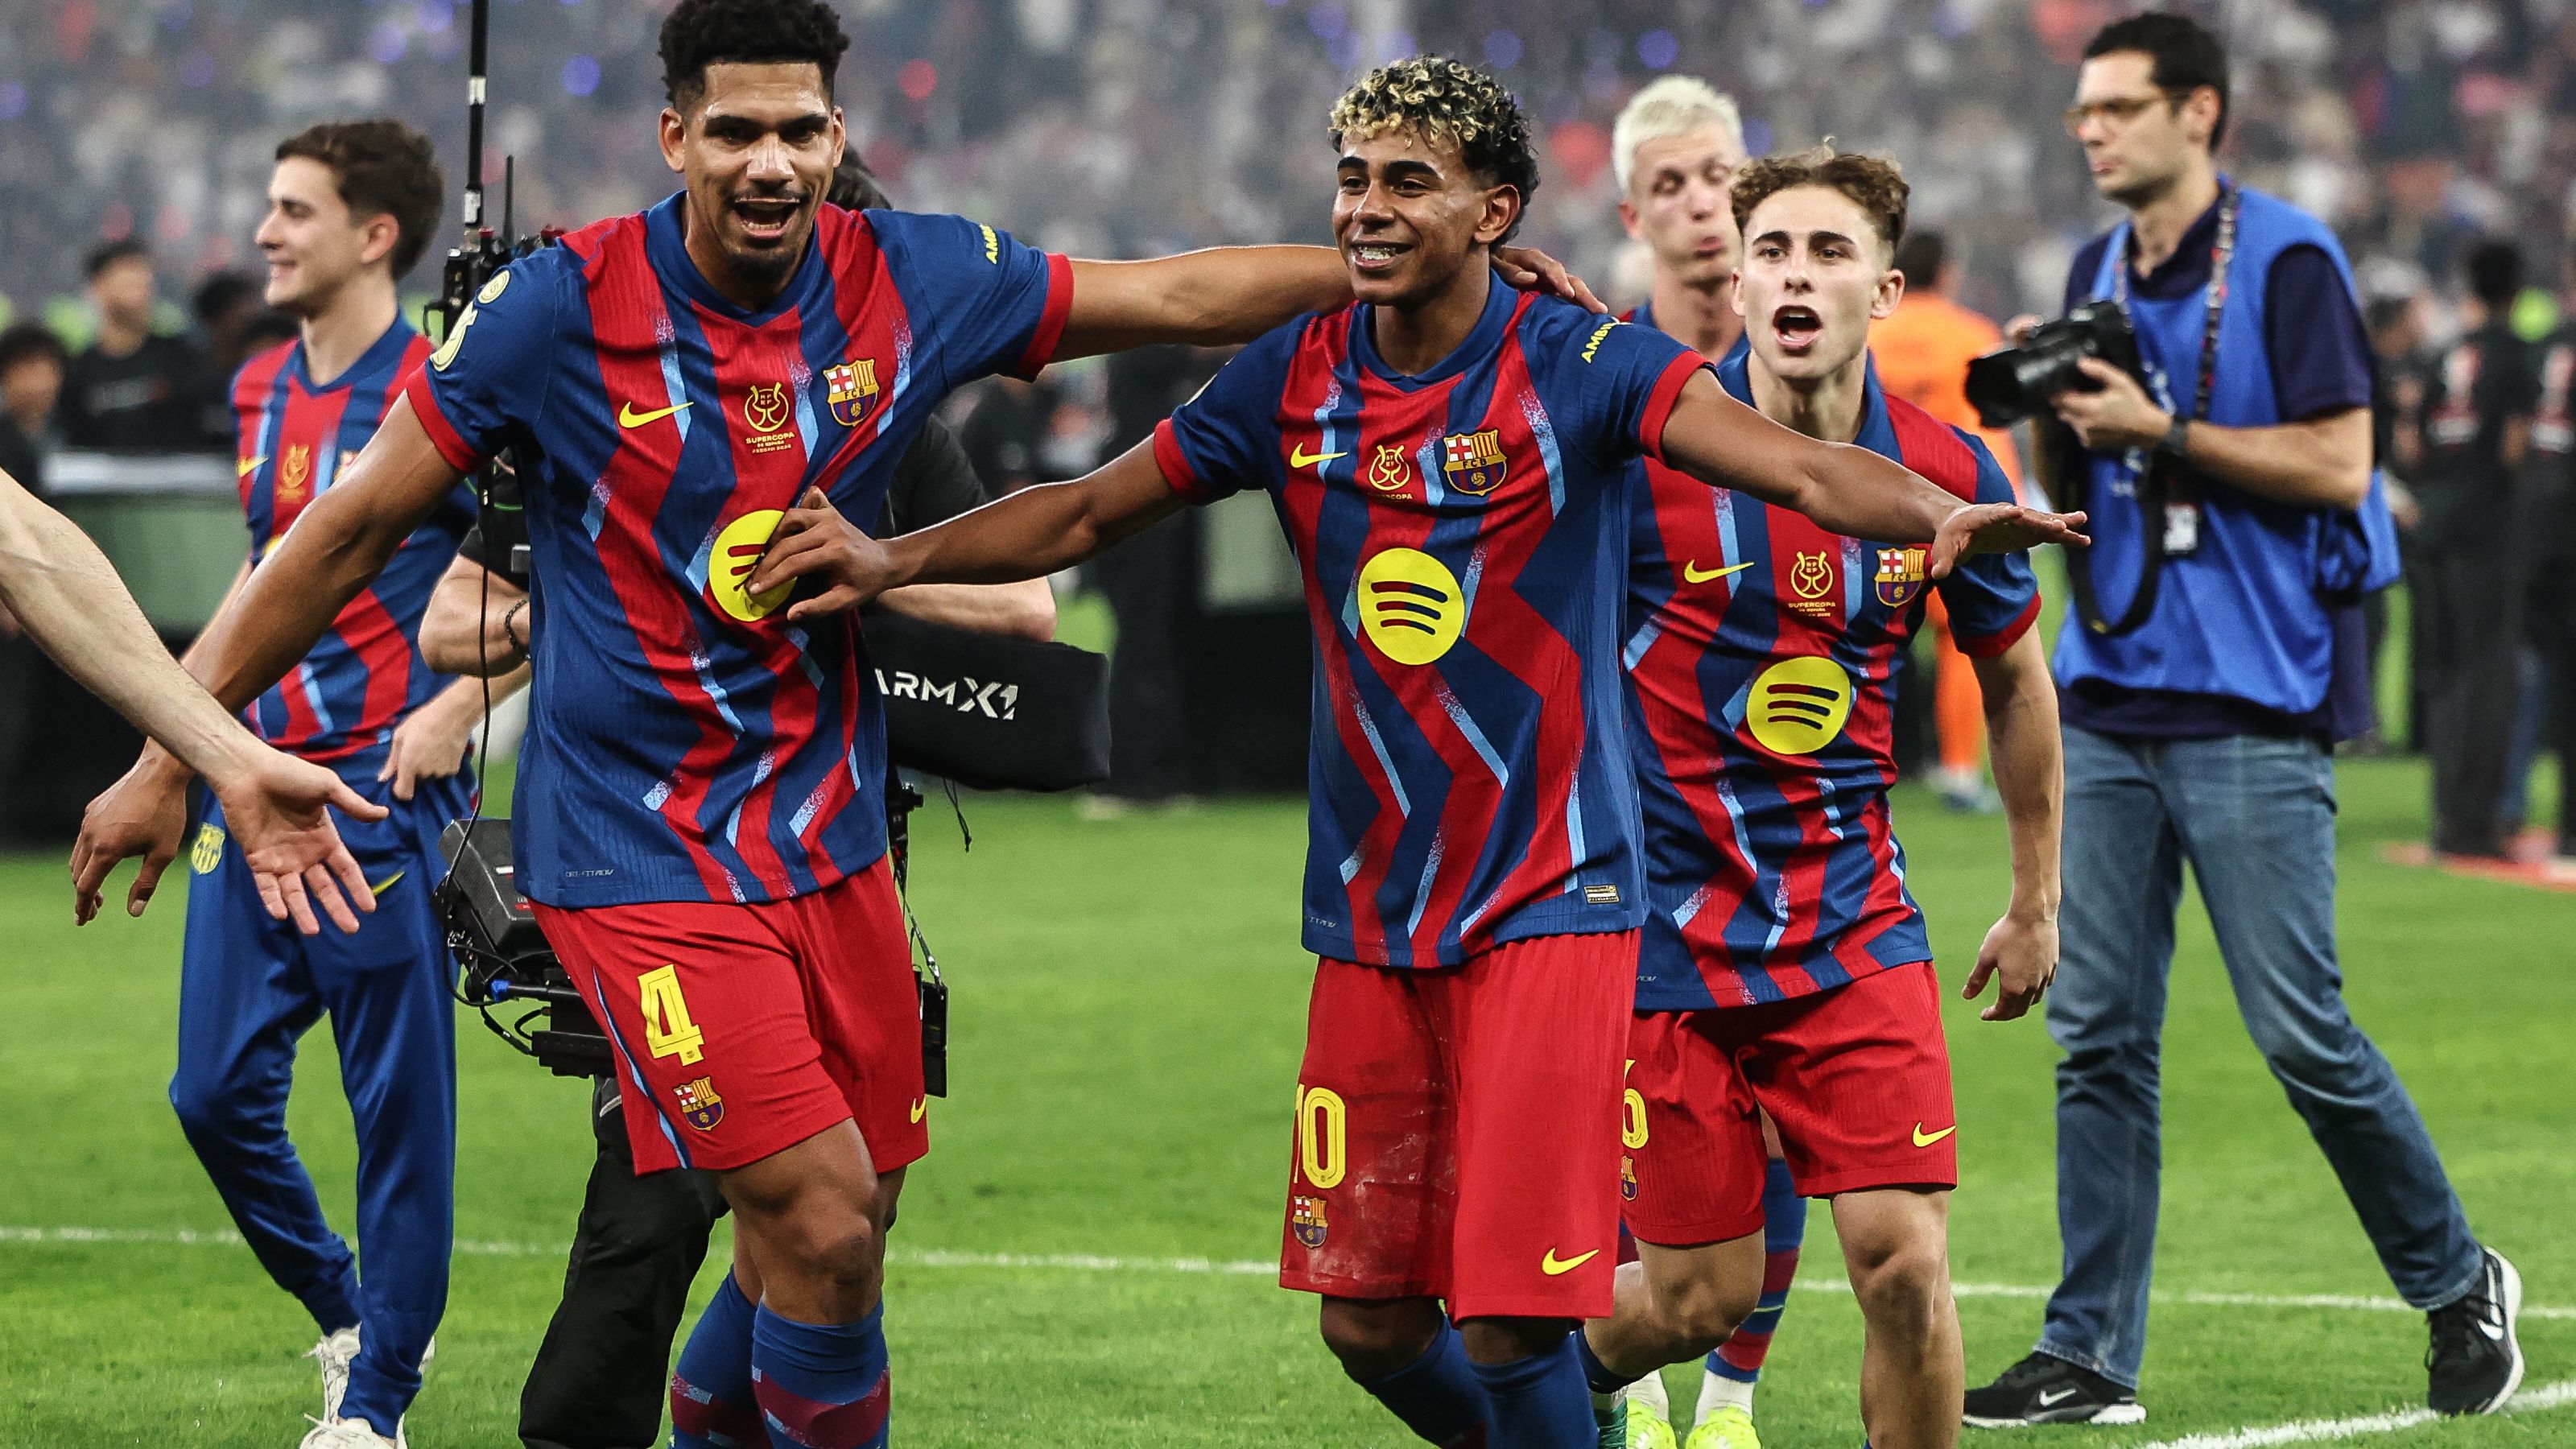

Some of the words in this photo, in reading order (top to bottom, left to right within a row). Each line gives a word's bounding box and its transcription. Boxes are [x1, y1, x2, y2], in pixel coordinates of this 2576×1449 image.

[745, 431, 795, 444] SUPERCOPA
[1788, 601, 1836, 609] SUPERCOPA
[637, 964, 705, 1067] 4
